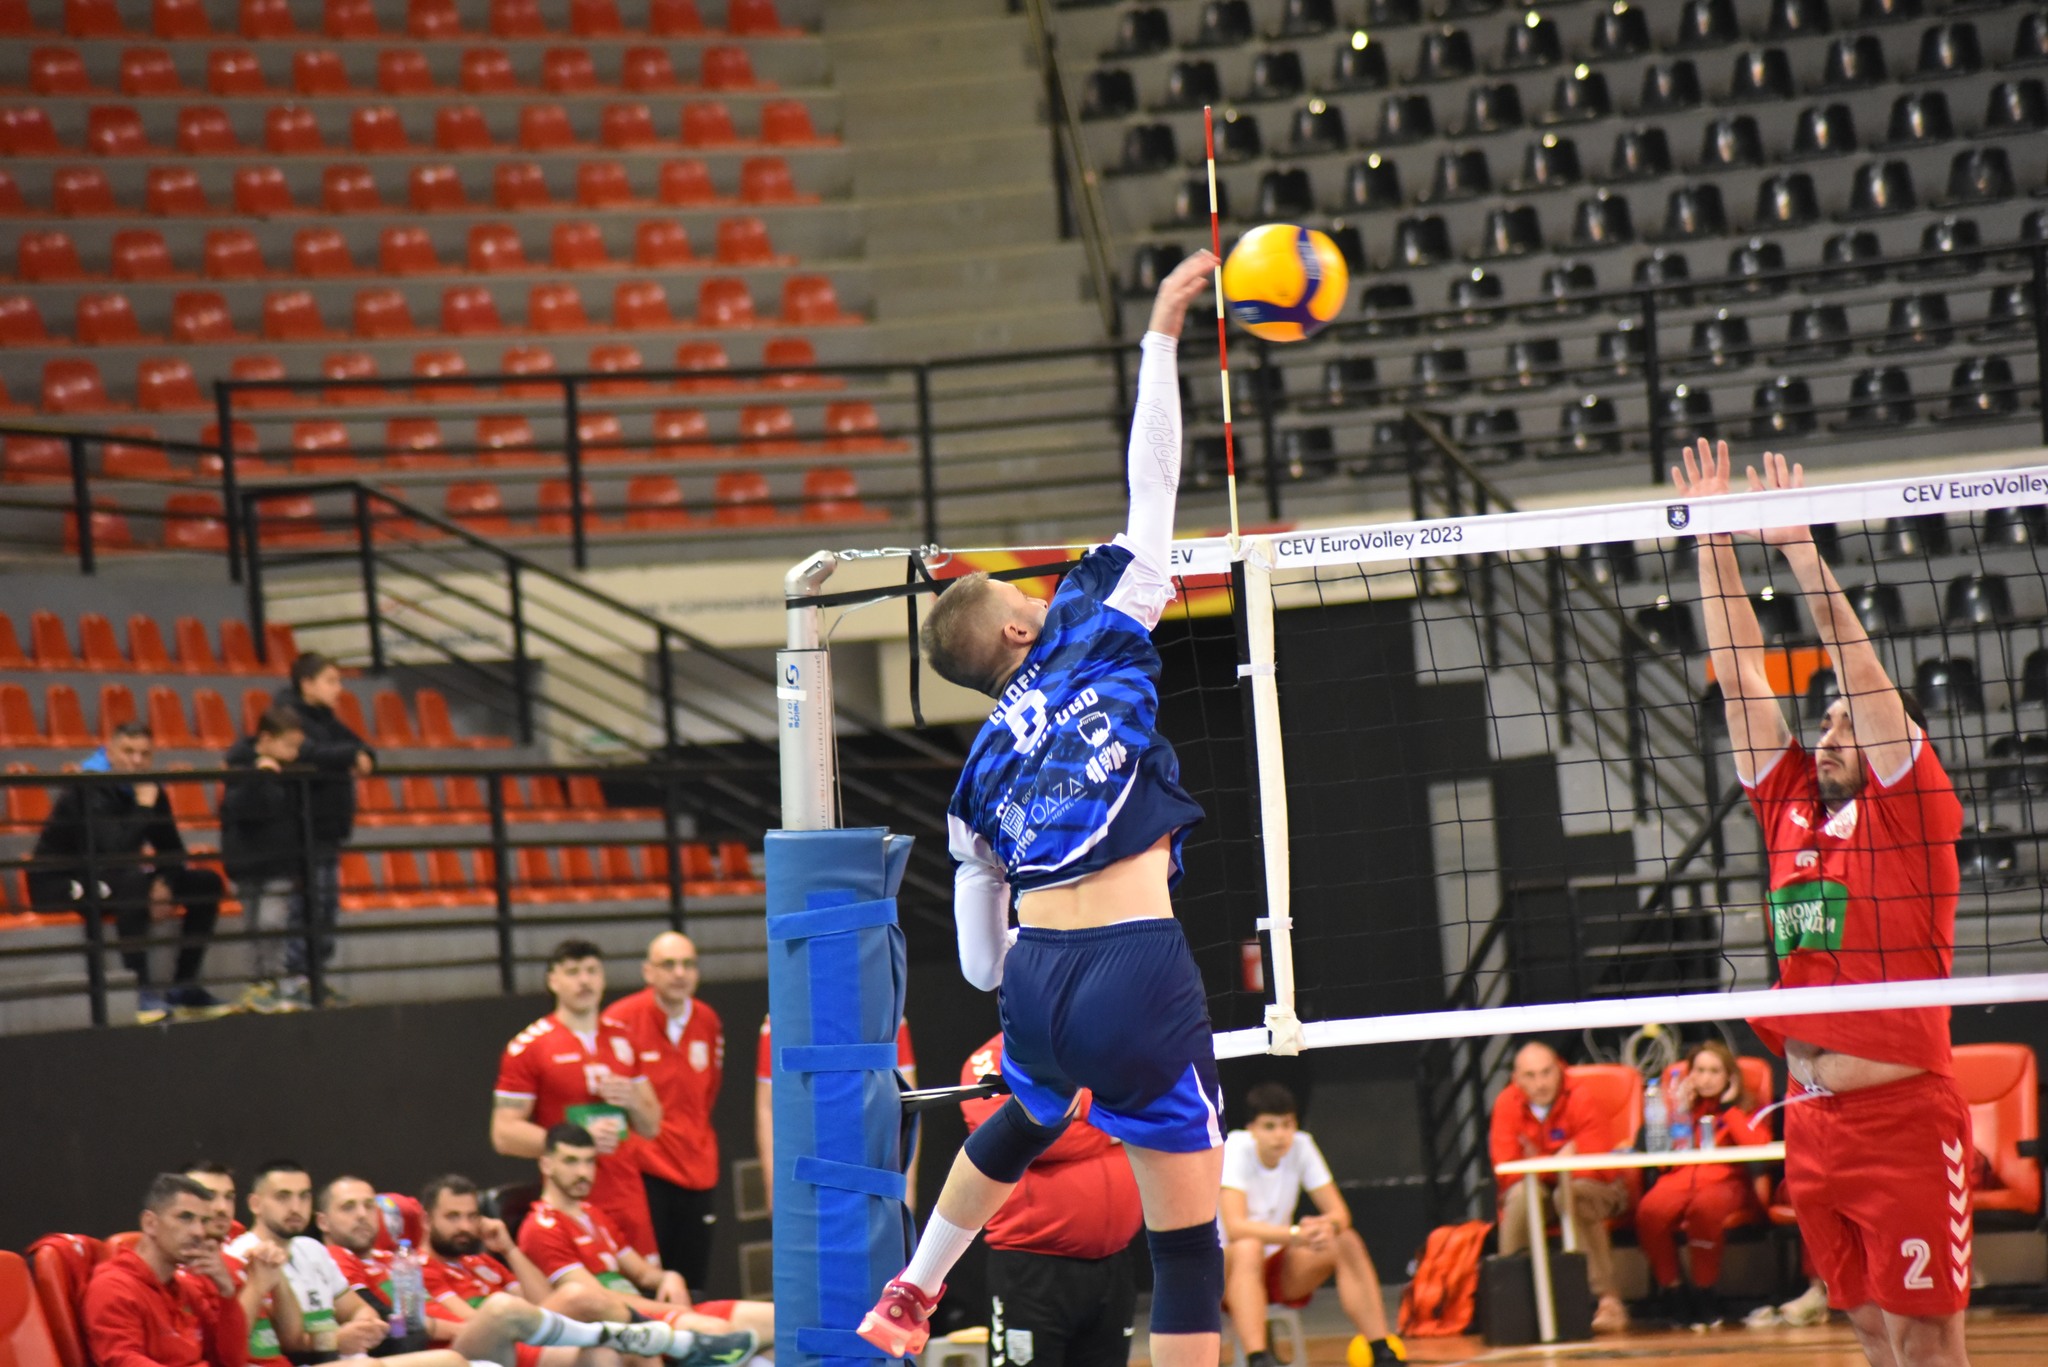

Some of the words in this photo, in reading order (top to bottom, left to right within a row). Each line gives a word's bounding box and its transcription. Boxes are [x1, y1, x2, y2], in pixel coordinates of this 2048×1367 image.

[1903, 483, 1943, 503] CEV
[1171, 549, 1193, 564] EV
[1279, 538, 1315, 557] CEV
[1320, 531, 1415, 553] EuroVolley
[1420, 525, 1463, 545] 2023
[1030, 777, 1085, 825] OAZA
[1051, 801, 1075, 822] HOTEL
[1900, 1238, 1934, 1290] 2
